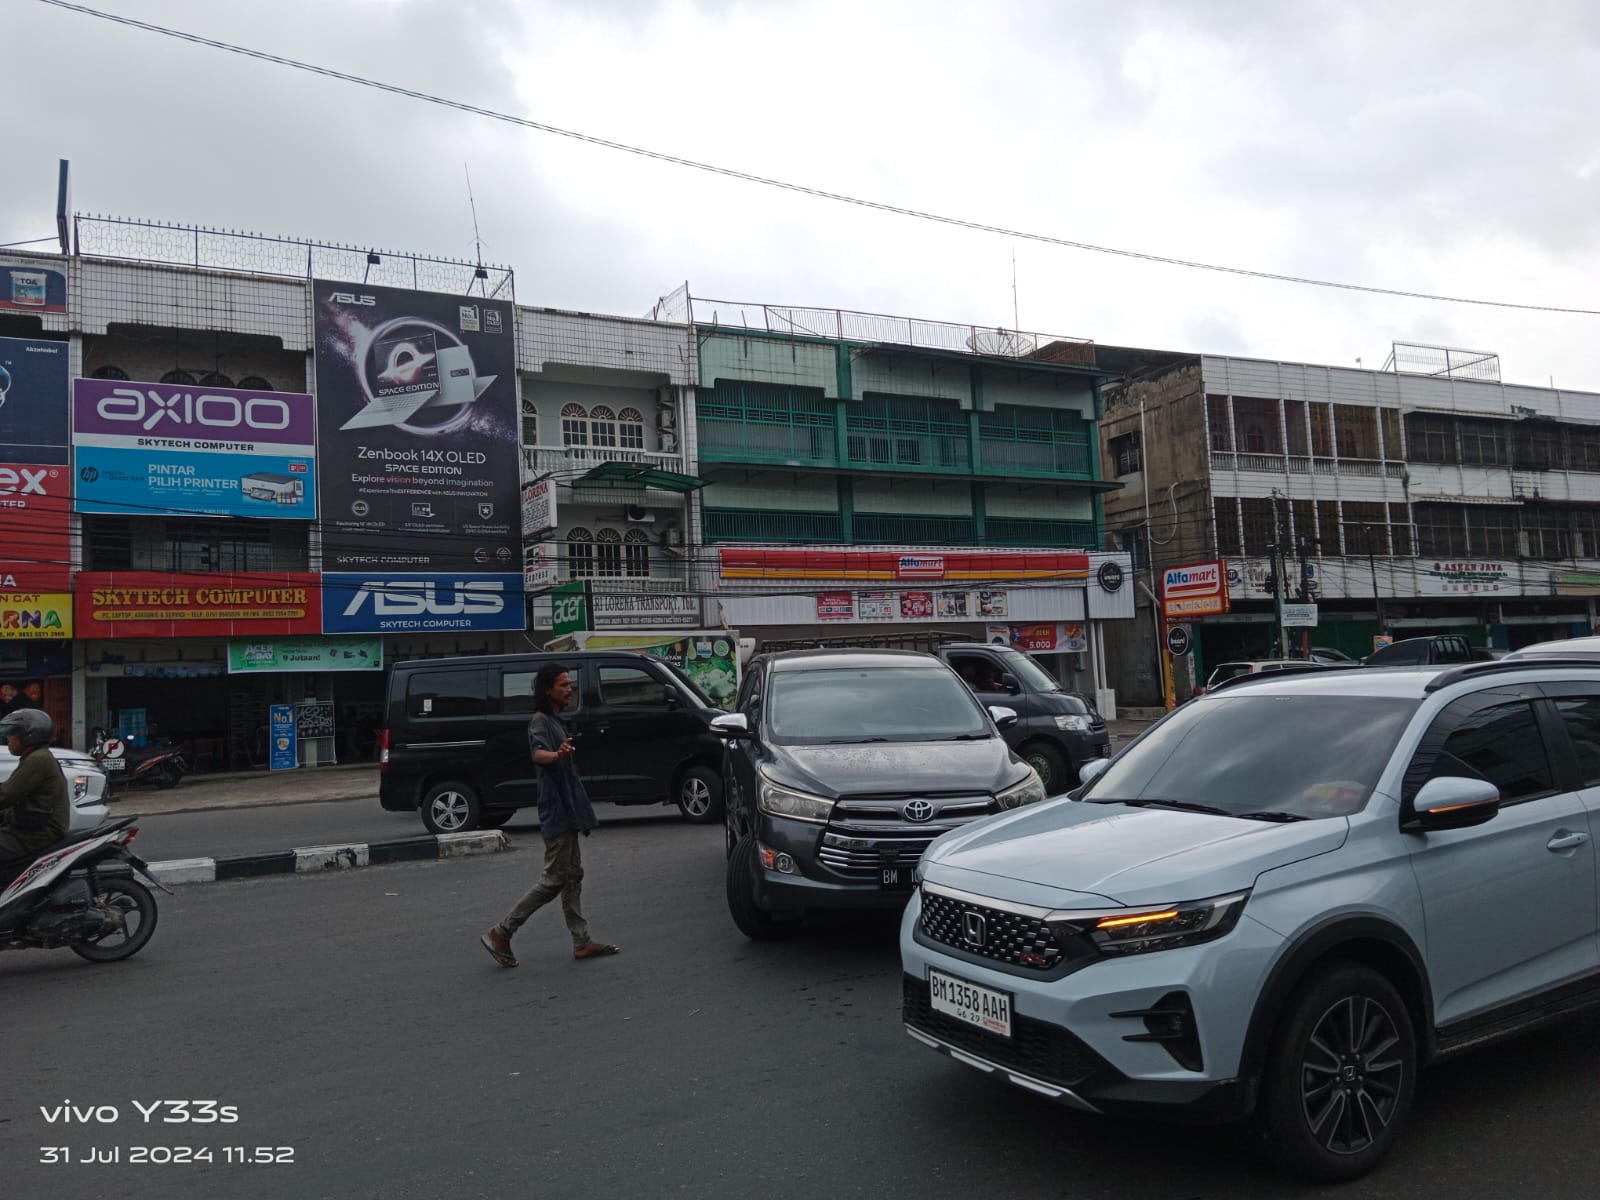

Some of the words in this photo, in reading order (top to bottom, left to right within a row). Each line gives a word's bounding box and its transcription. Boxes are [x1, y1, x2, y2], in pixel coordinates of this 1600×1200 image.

[328, 292, 376, 306] ASUS
[378, 386, 404, 396] SPACE
[405, 381, 440, 392] EDITION
[137, 438, 191, 449] SKYTECH
[194, 441, 255, 452] COMPUTER
[357, 446, 418, 461] Zenbook
[421, 450, 444, 463] 14X
[446, 451, 486, 465] OLED
[149, 464, 195, 476] PINTAR
[385, 463, 419, 473] SPACE
[421, 466, 462, 475] EDITION
[149, 476, 181, 488] PILIH
[183, 478, 239, 490] PRINTER
[351, 473, 385, 485] Explore
[386, 476, 411, 484] vision
[412, 476, 445, 486] beyond
[446, 478, 494, 489] imagination
[524, 481, 549, 502] LORENA
[337, 556, 378, 564] SKYTECH
[381, 556, 430, 565] COMPUTER
[899, 557, 943, 568] Alfamart
[1166, 568, 1217, 586] Alfamart
[12, 594, 41, 602] CAT
[92, 588, 190, 606] SKYTECH
[196, 588, 308, 605] COMPUTER
[343, 582, 505, 616] ASUS
[554, 596, 581, 625] acer
[380, 620, 421, 629] SKYTECH
[422, 620, 472, 629] COMPUTER
[1029, 641, 1051, 649] 5.000
[289, 654, 321, 662] Jutaan!
[273, 710, 293, 724] No.1
[883, 869, 898, 884] BM
[932, 975, 948, 1001] BM
[949, 982, 980, 1013] 1358
[982, 993, 1008, 1024] AAH
